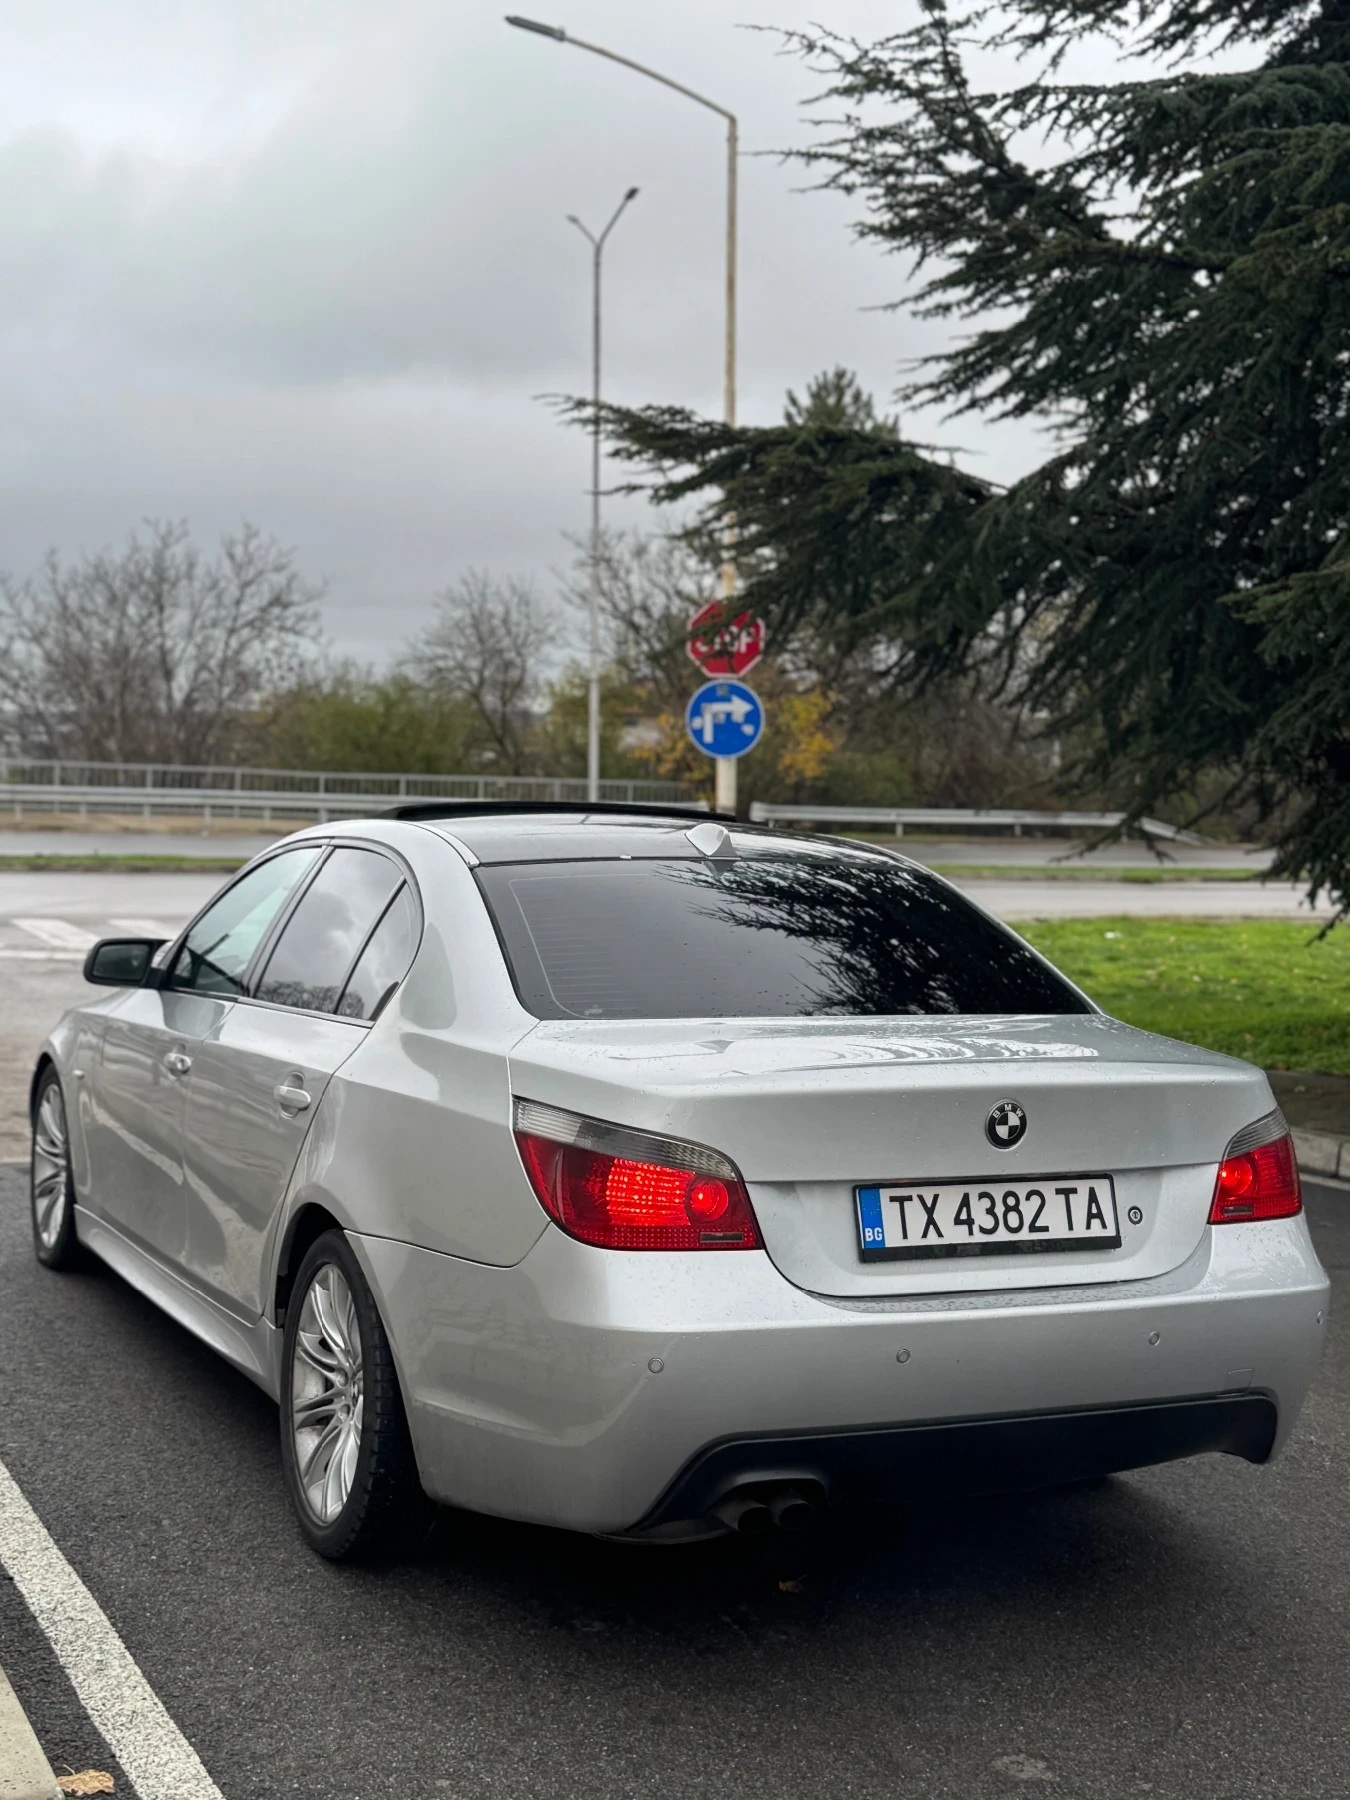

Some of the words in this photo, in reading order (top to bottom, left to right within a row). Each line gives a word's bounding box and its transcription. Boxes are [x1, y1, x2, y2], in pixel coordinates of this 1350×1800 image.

[992, 1103, 1024, 1118] BMW
[889, 1193, 944, 1239] TX
[953, 1190, 1049, 1236] 4382
[1054, 1186, 1108, 1231] TA
[864, 1227, 883, 1242] BG
